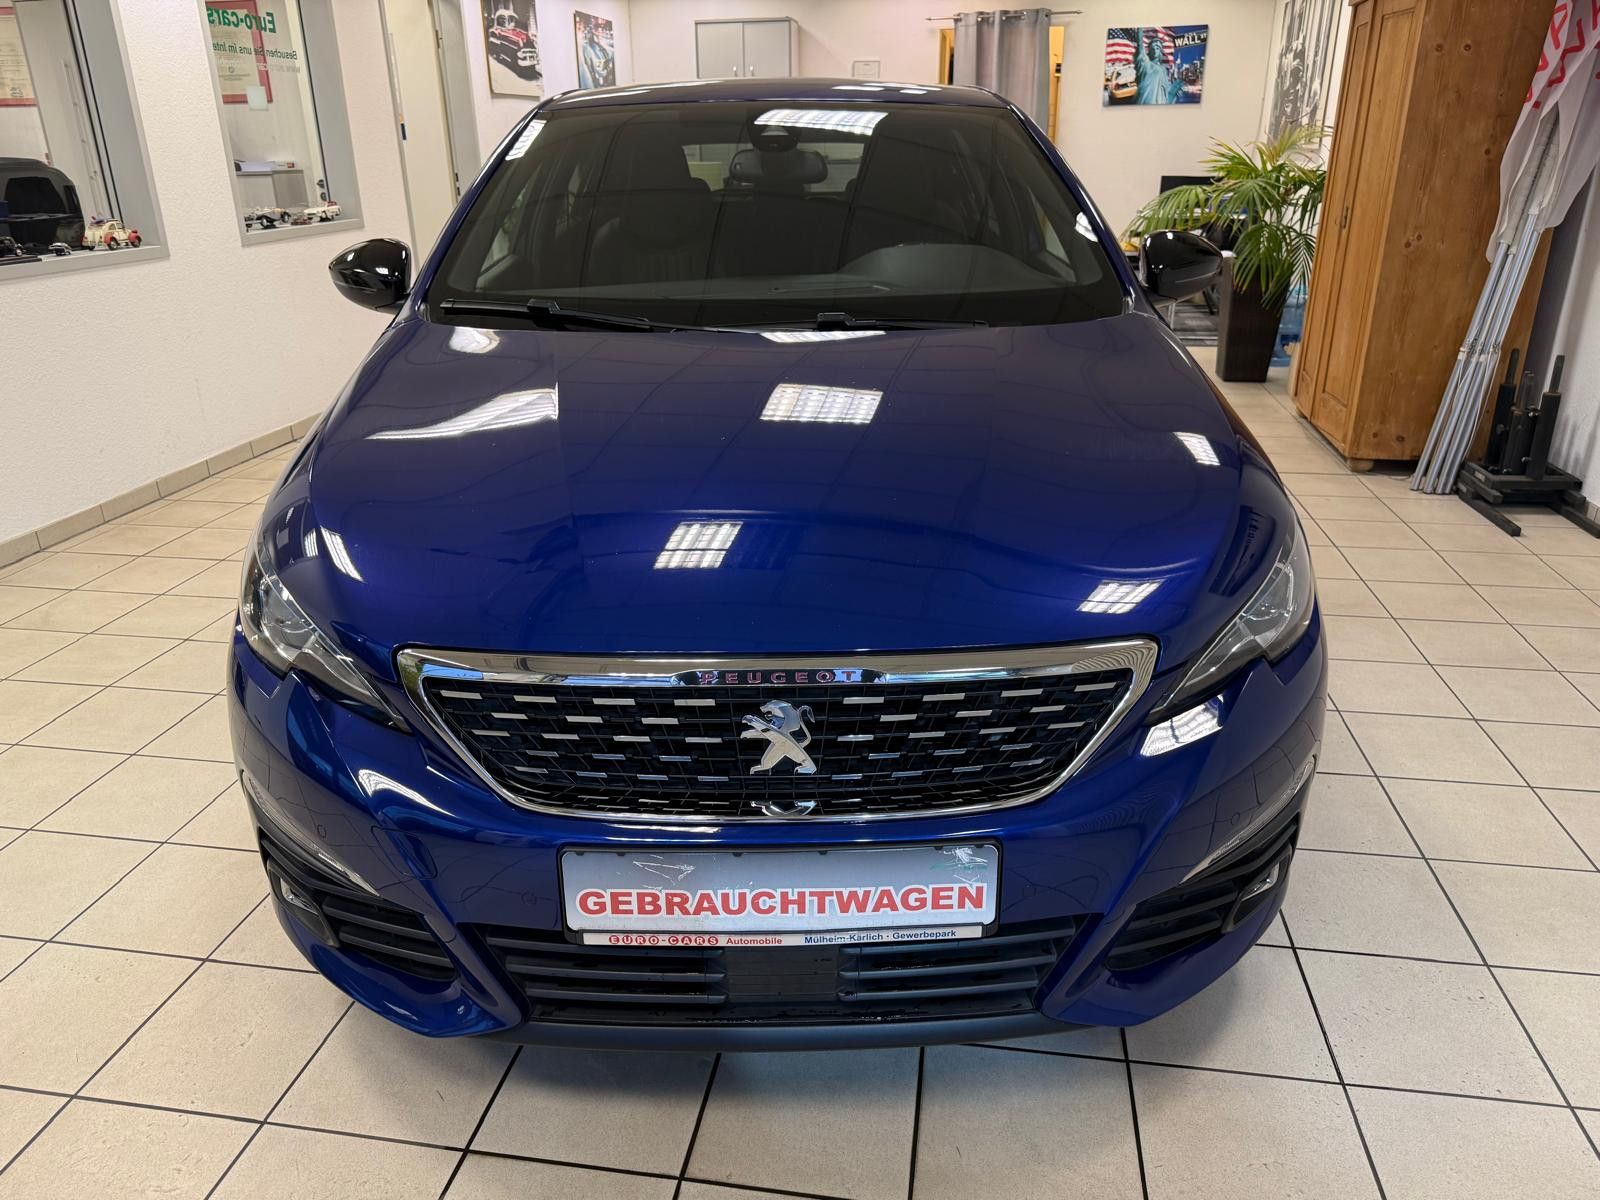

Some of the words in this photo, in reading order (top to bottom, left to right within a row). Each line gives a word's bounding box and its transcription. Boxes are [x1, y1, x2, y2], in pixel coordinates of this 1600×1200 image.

[1174, 36, 1200, 47] WALL
[700, 670, 858, 685] PEUGEOT
[577, 885, 985, 916] GEBRAUCHTWAGEN
[608, 934, 719, 946] EURO-CARS
[726, 937, 783, 945] Automobile
[893, 929, 957, 941] Gewerbepark
